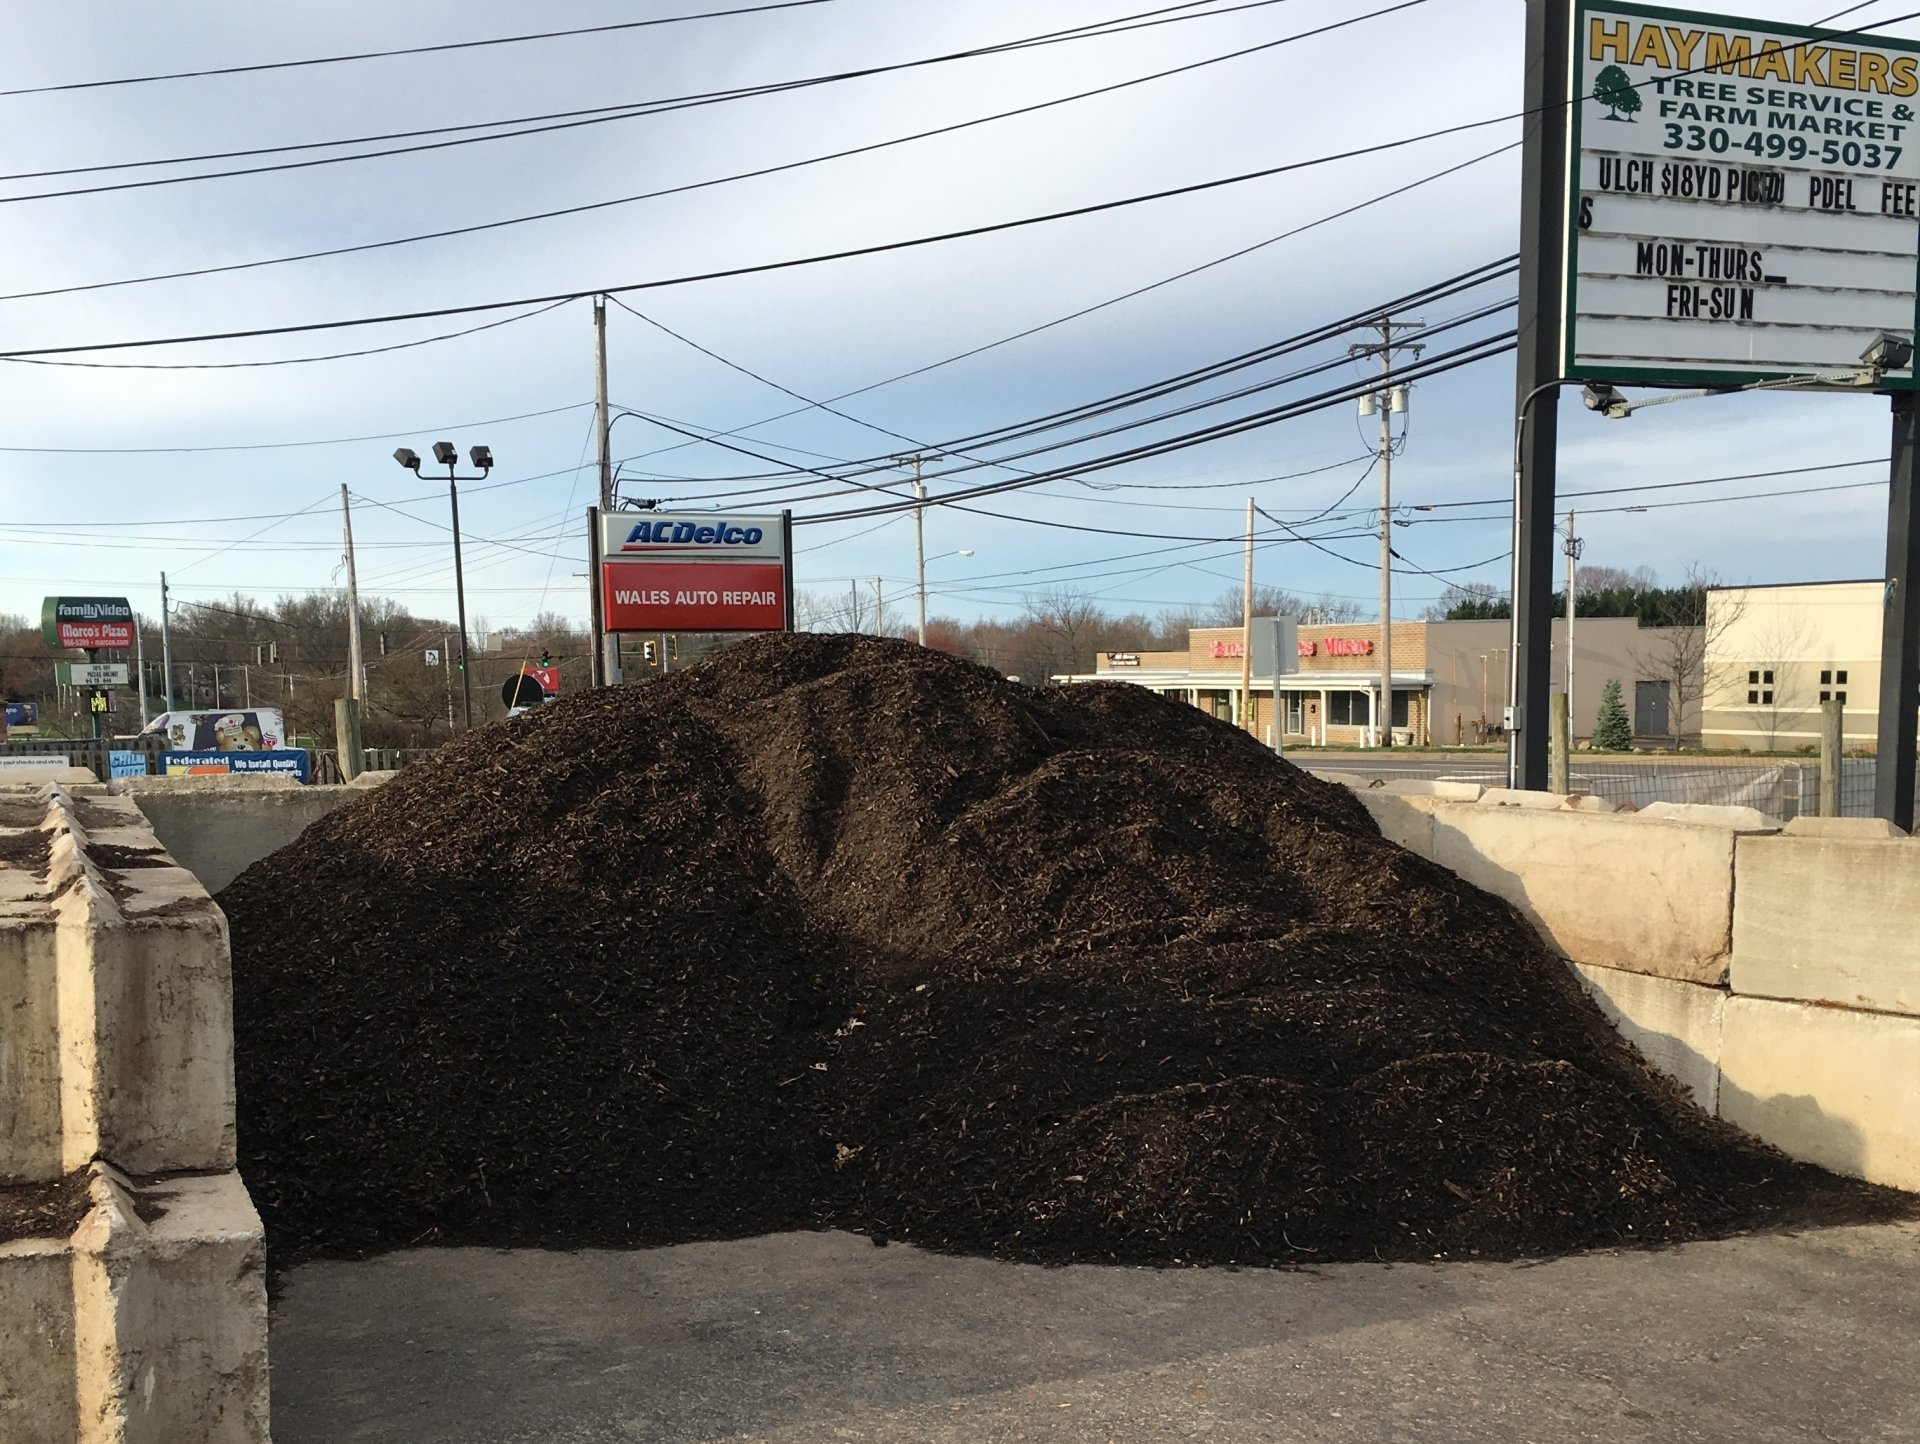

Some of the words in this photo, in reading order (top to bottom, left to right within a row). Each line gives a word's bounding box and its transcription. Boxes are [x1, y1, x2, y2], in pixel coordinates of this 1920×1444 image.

[1590, 17, 1919, 98] HAYMAKERS
[1650, 76, 1736, 102] TREE
[1747, 87, 1883, 118] SERVICE
[1892, 104, 1915, 122] &
[1659, 99, 1757, 127] FARM
[1767, 111, 1906, 141] MARKET
[1663, 123, 1903, 170] 330-499-5037
[1600, 157, 1654, 193] ULCH
[1881, 182, 1916, 216] FEE
[1578, 196, 1593, 230] S
[626, 521, 763, 545] ACDelco
[615, 590, 670, 605] WALES
[675, 590, 718, 605] AUTO
[723, 591, 776, 606] REPAIR
[62, 624, 99, 637] Marco's
[102, 624, 128, 637] Pizza
[165, 756, 229, 765] Federated
[235, 759, 247, 768] We
[248, 759, 271, 768] Install
[272, 760, 298, 769] Quality
